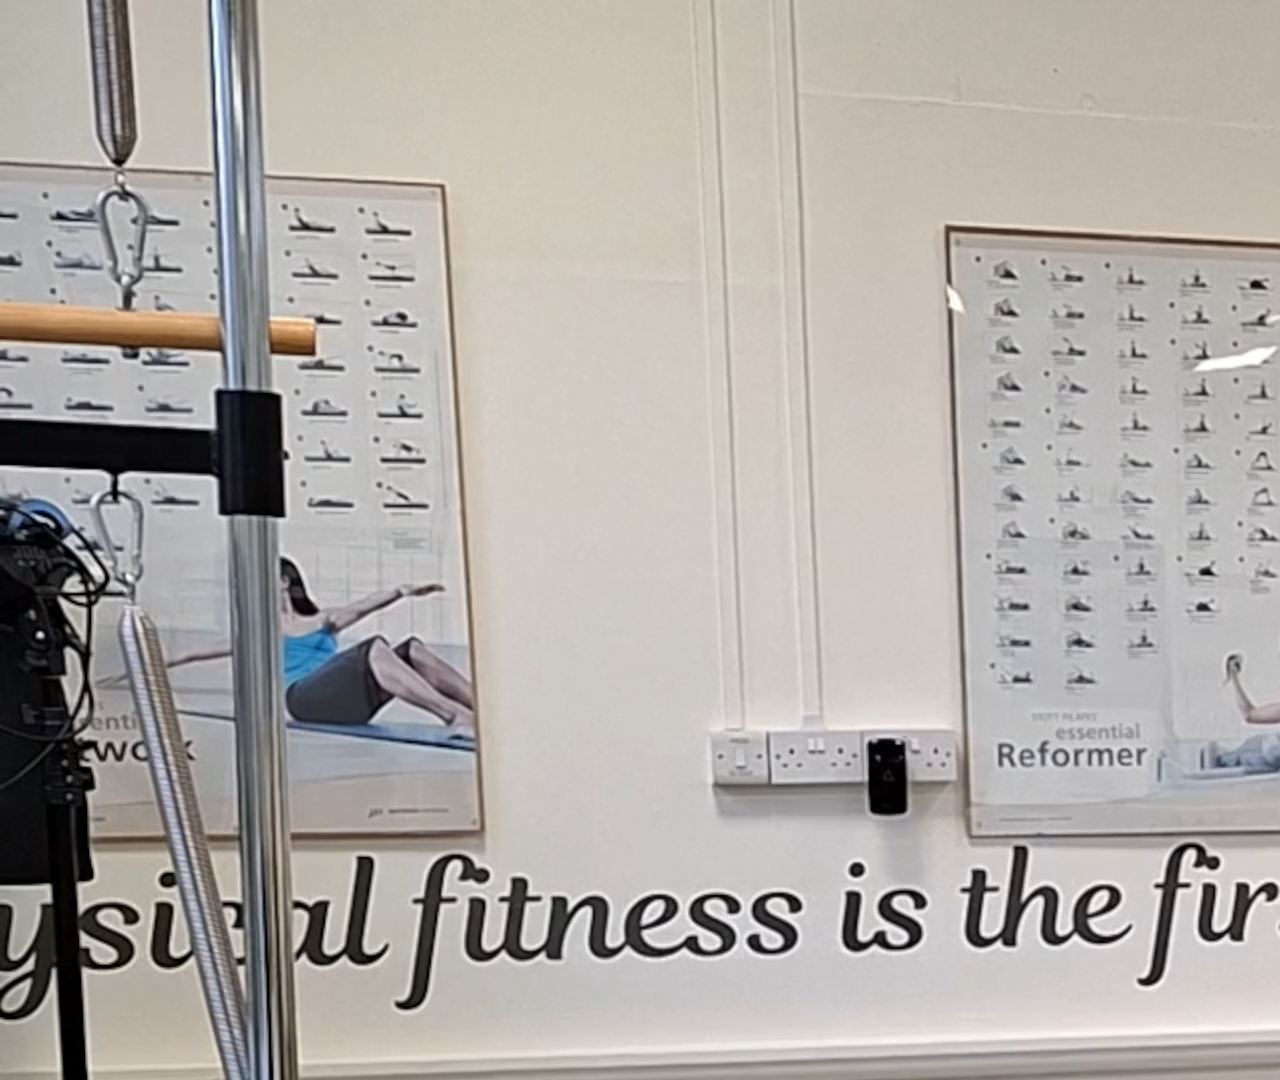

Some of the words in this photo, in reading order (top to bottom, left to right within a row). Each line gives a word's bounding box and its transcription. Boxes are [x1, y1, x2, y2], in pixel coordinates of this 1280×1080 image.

[1055, 722, 1141, 741] essential
[997, 740, 1148, 768] Reformer
[395, 853, 803, 1011] fitness
[841, 862, 928, 953] is
[959, 845, 1132, 948] the
